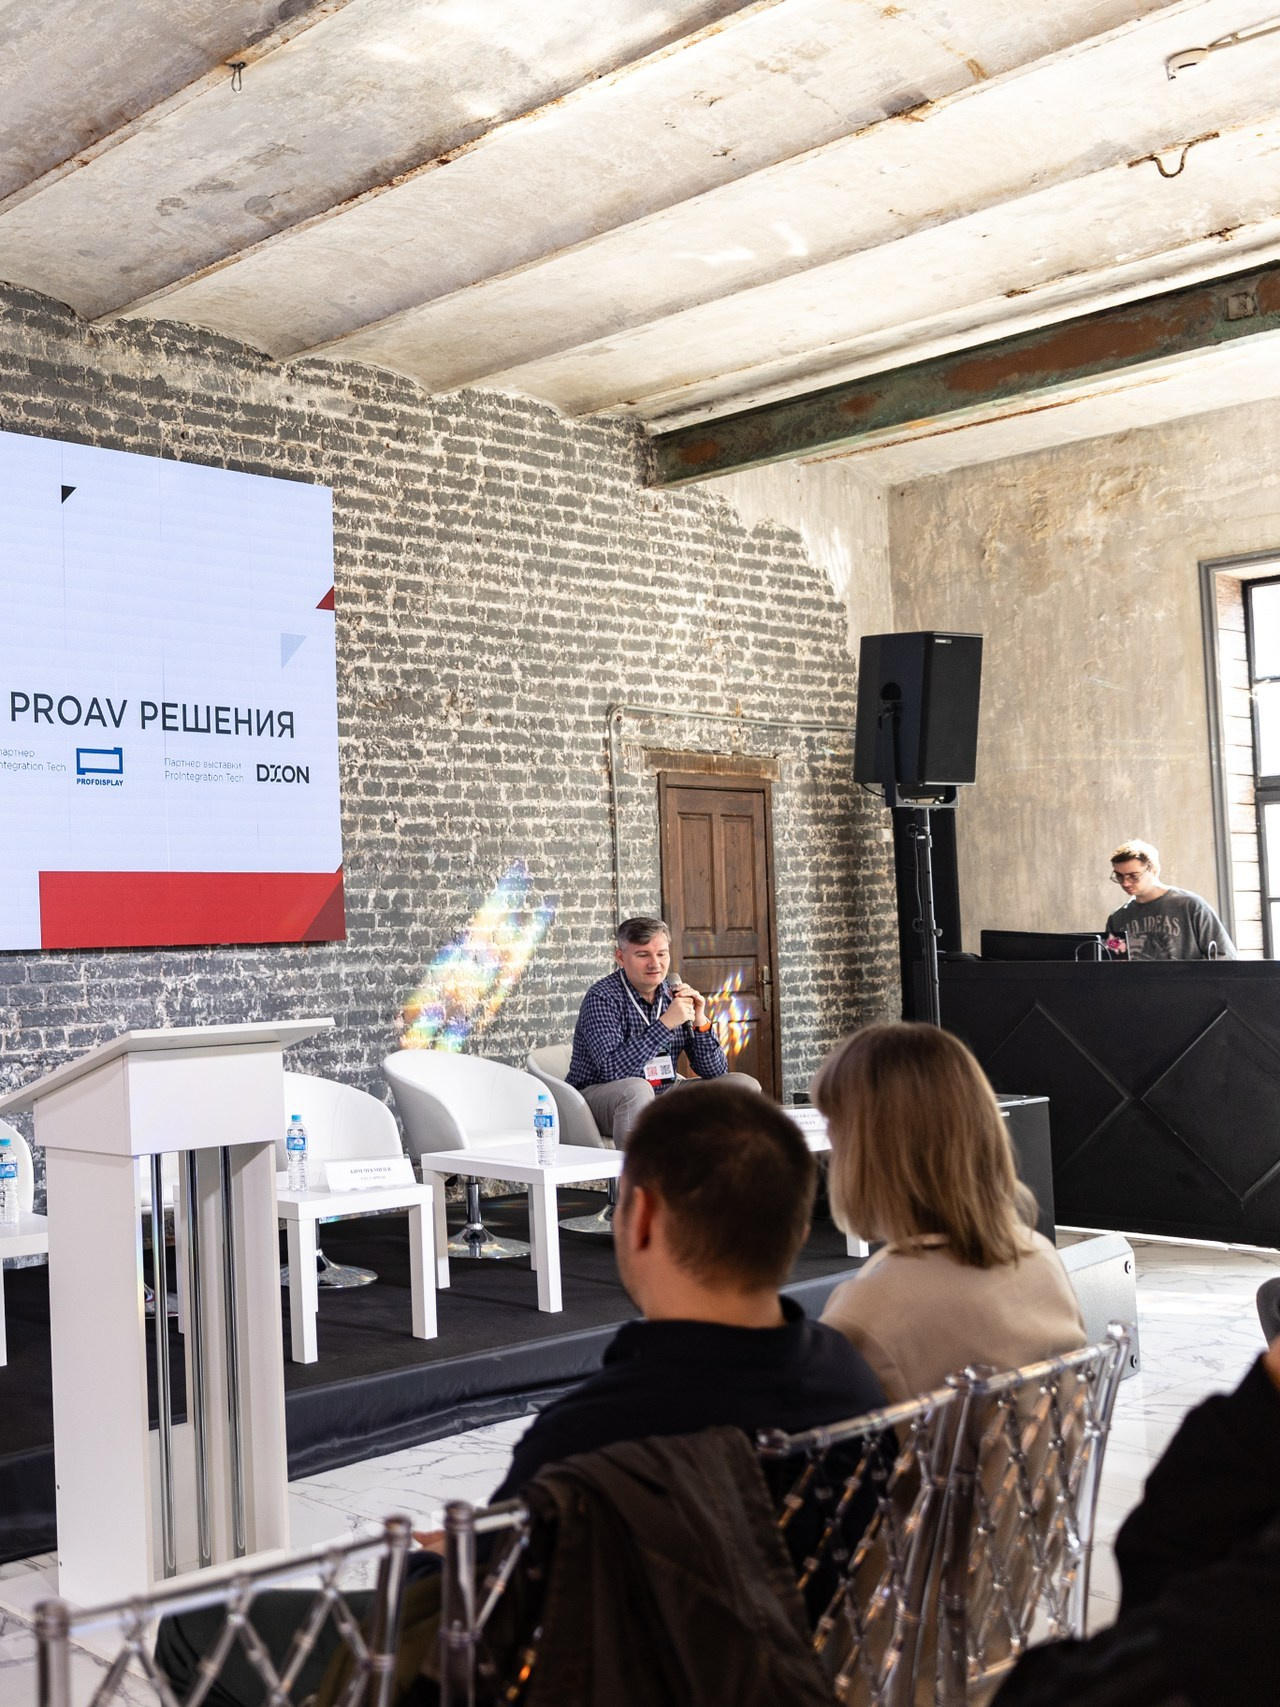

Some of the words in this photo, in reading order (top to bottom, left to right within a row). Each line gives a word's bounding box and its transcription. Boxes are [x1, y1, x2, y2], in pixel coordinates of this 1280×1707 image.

[10, 691, 128, 729] PROAV
[140, 700, 295, 738] РЕШЕНИЯ
[46, 761, 67, 772] Tech
[164, 757, 201, 769] Партнер
[203, 760, 242, 770] выставки
[76, 778, 124, 787] PROFDISPLAY
[164, 770, 224, 783] ProIntegration
[226, 772, 244, 783] Tech
[1143, 915, 1181, 937] IDEAS
